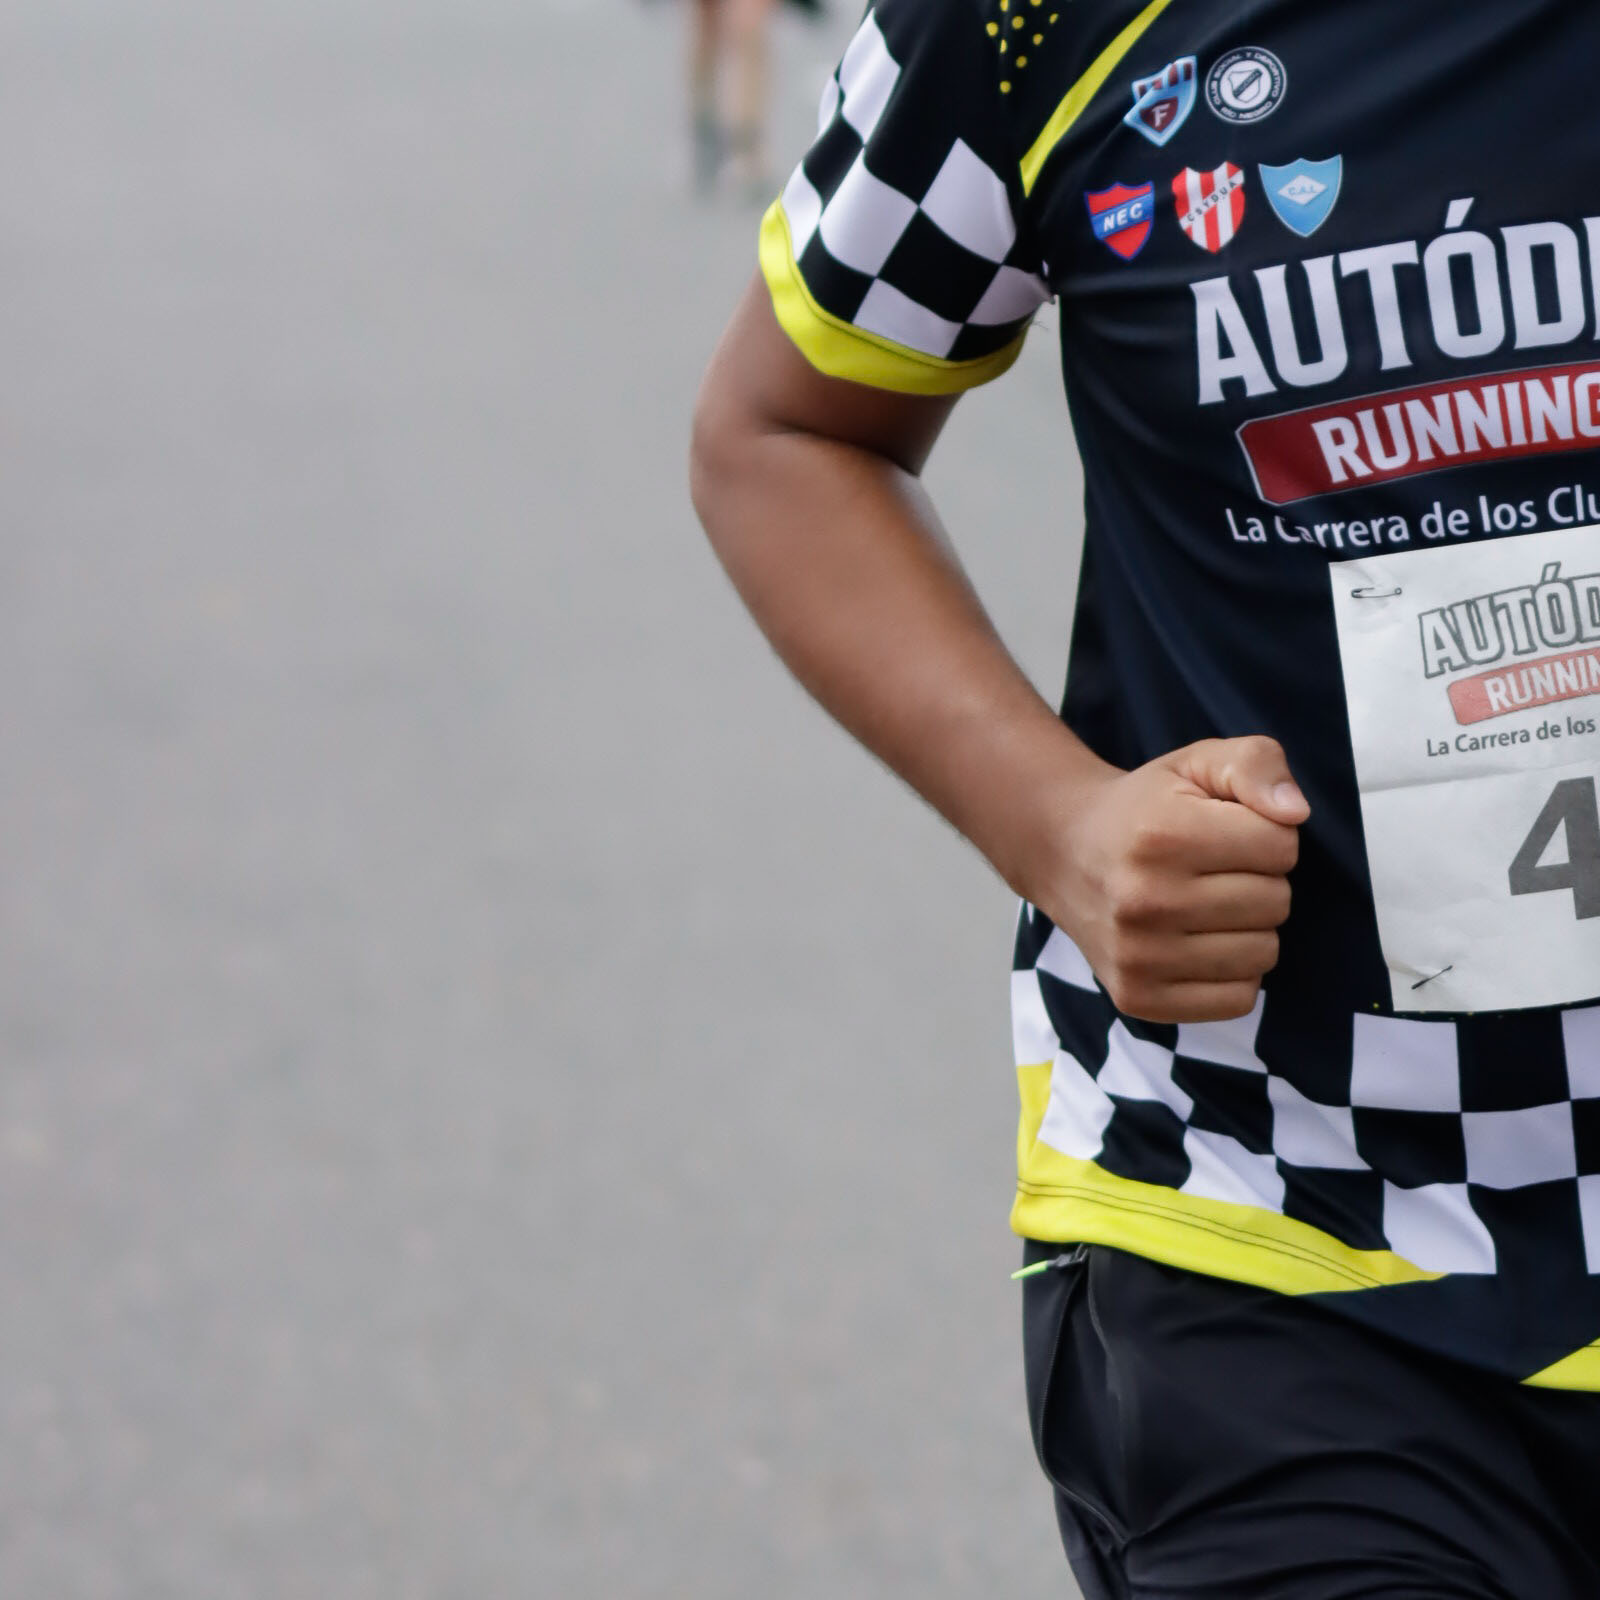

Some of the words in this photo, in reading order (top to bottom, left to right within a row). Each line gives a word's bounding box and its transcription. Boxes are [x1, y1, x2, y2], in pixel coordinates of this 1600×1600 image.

[1152, 103, 1171, 128] F
[1225, 508, 1267, 542] La
[1420, 501, 1470, 538] de
[1478, 495, 1538, 533] los
[1427, 738, 1449, 757] La
[1455, 728, 1530, 752] Carrera
[1536, 720, 1562, 740] de
[1567, 715, 1596, 735] los
